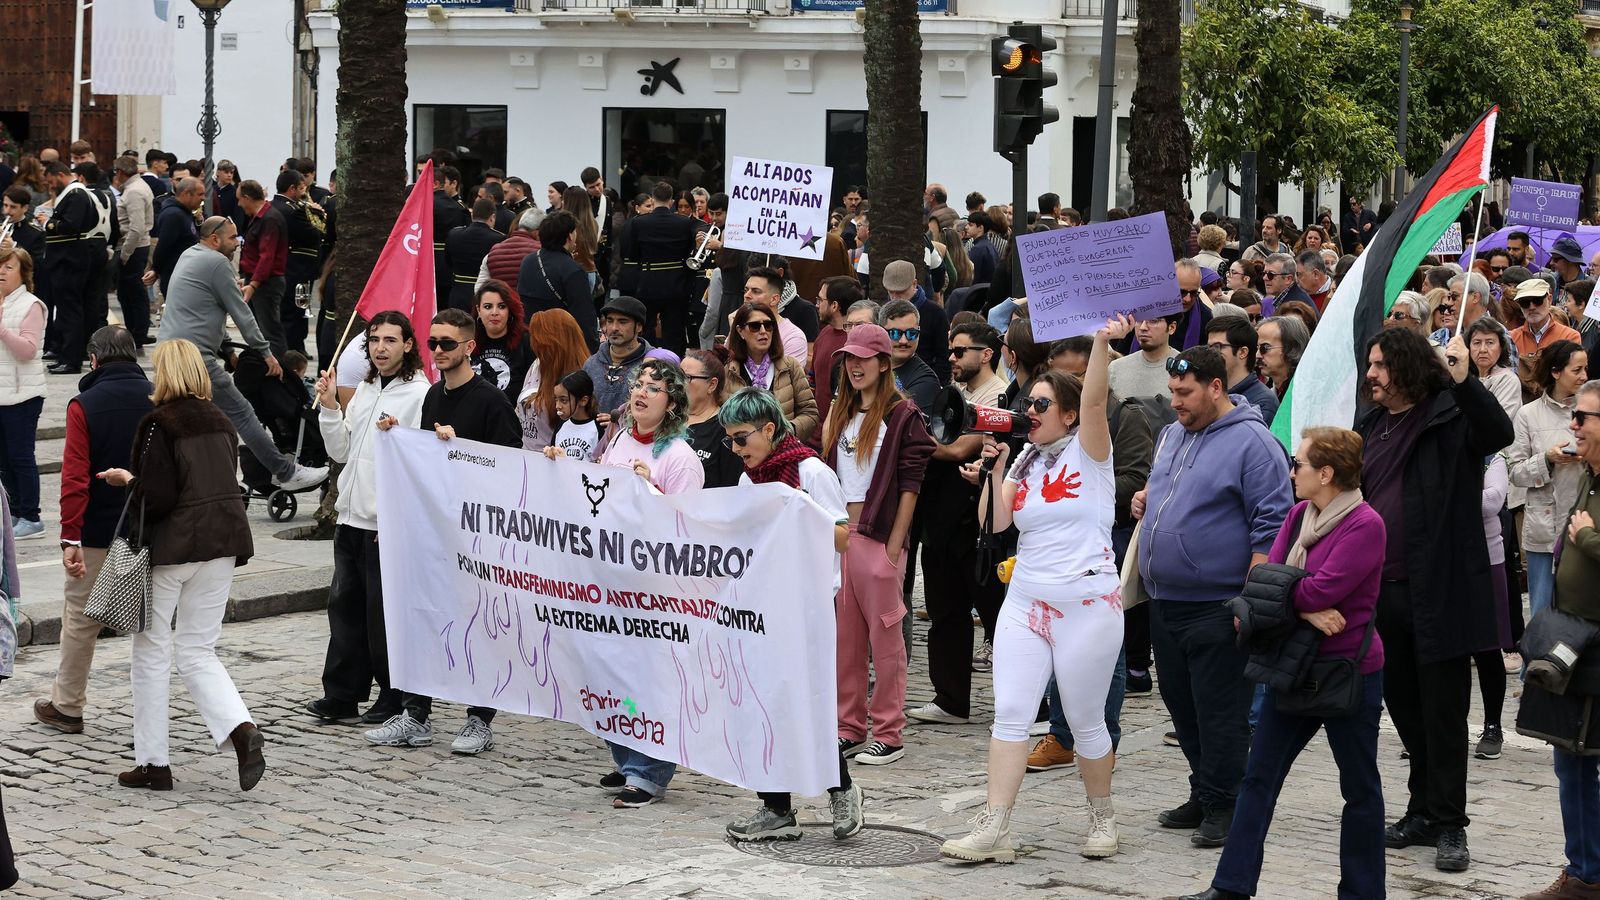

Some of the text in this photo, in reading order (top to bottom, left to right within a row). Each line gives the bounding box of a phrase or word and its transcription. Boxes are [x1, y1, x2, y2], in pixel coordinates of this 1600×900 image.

[744, 161, 812, 185] ALIADOS
[732, 185, 822, 208] ACOMPAÑAN
[1511, 184, 1544, 195] FEMINISMO
[1551, 189, 1580, 199] IGUALDAD
[760, 207, 787, 219] EN LA
[1509, 210, 1576, 226] QUE NO TE CONFUNDAN
[747, 217, 798, 240] LUCHA
[1022, 236, 1059, 253] BUENO,
[1093, 228, 1112, 239] MUY
[1114, 223, 1151, 236] RARO
[1030, 244, 1134, 275] SOIS UNAS EXAGERADAS
[1031, 274, 1068, 290] MANOLO,
[1085, 271, 1125, 281] PIENSAS
[1128, 267, 1149, 277] ESO
[1035, 274, 1165, 310] MÍRAME Y DALE UNA VUELTA
[1057, 317, 1068, 325] NO
[1069, 311, 1097, 322] TENGO
[559, 437, 591, 453] HELLFIRE
[566, 448, 581, 458] CLUB
[697, 449, 711, 459] OW
[461, 501, 481, 533] NI
[485, 504, 593, 559] TRADWIVES
[600, 528, 624, 565] NI
[474, 560, 491, 582] UN
[491, 565, 602, 604] TRANSFEMINISMO
[717, 604, 766, 635] CONTRA
[534, 603, 690, 644] LA EXTREMA DERECHA
